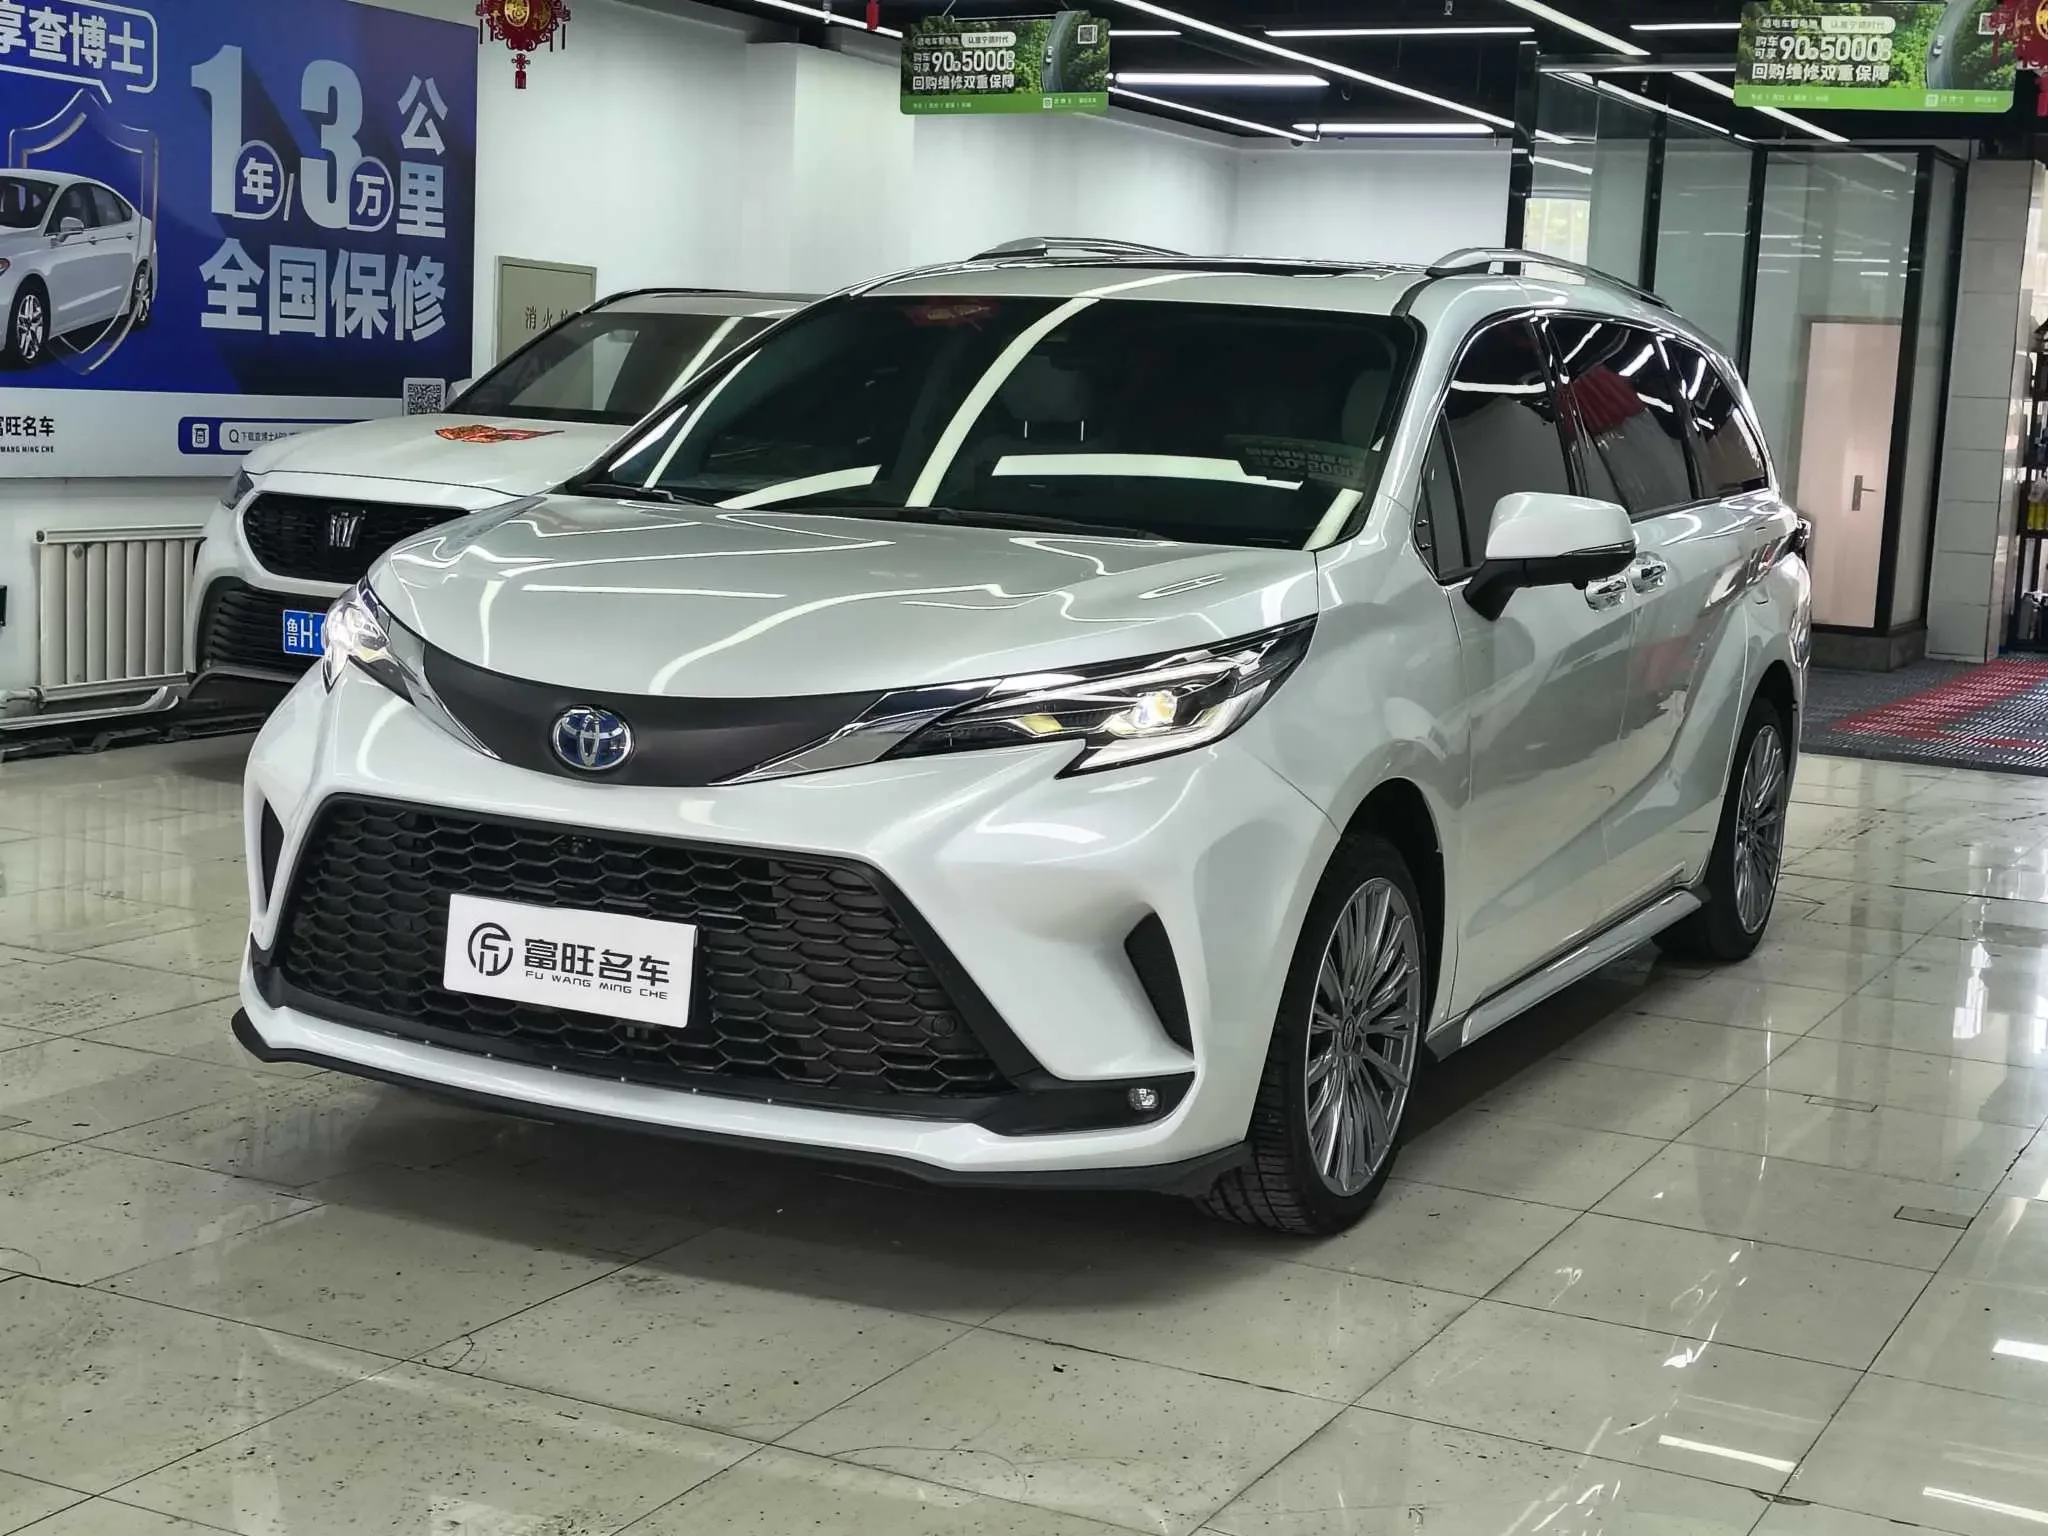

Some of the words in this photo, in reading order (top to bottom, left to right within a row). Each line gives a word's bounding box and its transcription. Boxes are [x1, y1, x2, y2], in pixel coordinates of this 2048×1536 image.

[912, 73, 1016, 91] 回购维修双重保障
[1751, 63, 1891, 82] 回购维修双重保障
[199, 238, 447, 343] 全国保修
[0, 416, 55, 437] 旺名车
[524, 938, 670, 987] 富旺名车
[525, 970, 544, 981] FU
[551, 974, 591, 988] WANG
[599, 982, 632, 995] MING
[639, 988, 669, 1000] CHE
